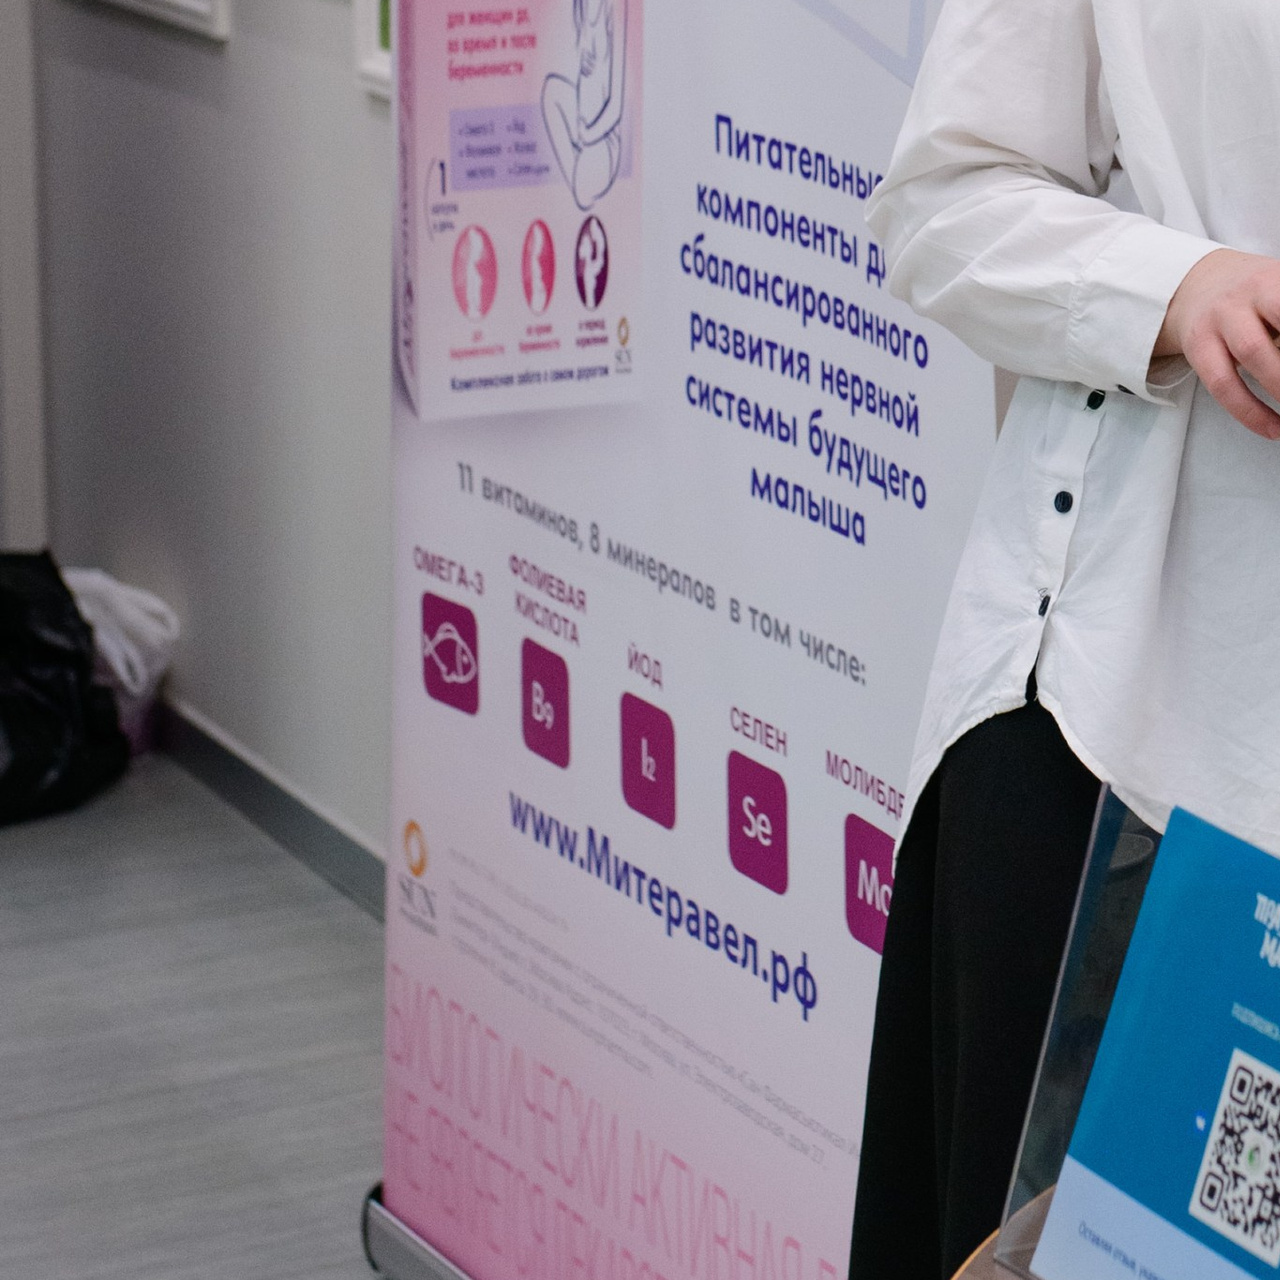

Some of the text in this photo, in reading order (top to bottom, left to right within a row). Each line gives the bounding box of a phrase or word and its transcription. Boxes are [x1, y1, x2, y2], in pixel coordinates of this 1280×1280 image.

[697, 182, 858, 268] компоненты
[681, 233, 929, 370] сбалансированного
[690, 311, 810, 385] развития
[821, 360, 920, 438] нервной
[686, 374, 928, 510] системы будущего
[751, 467, 867, 547] малыша
[413, 545, 485, 596] ОМЕГА-3
[457, 462, 867, 685] 11 витаминов, 8 минералов в том числе:
[509, 554, 587, 614] ФОЛИЕВАЯ
[515, 591, 580, 648] КИСЛОТА
[627, 641, 664, 691] ЙОД
[729, 705, 788, 757] СЕЛЕН
[741, 795, 773, 847] Se
[509, 791, 818, 1021] www.Митеравел.рф
